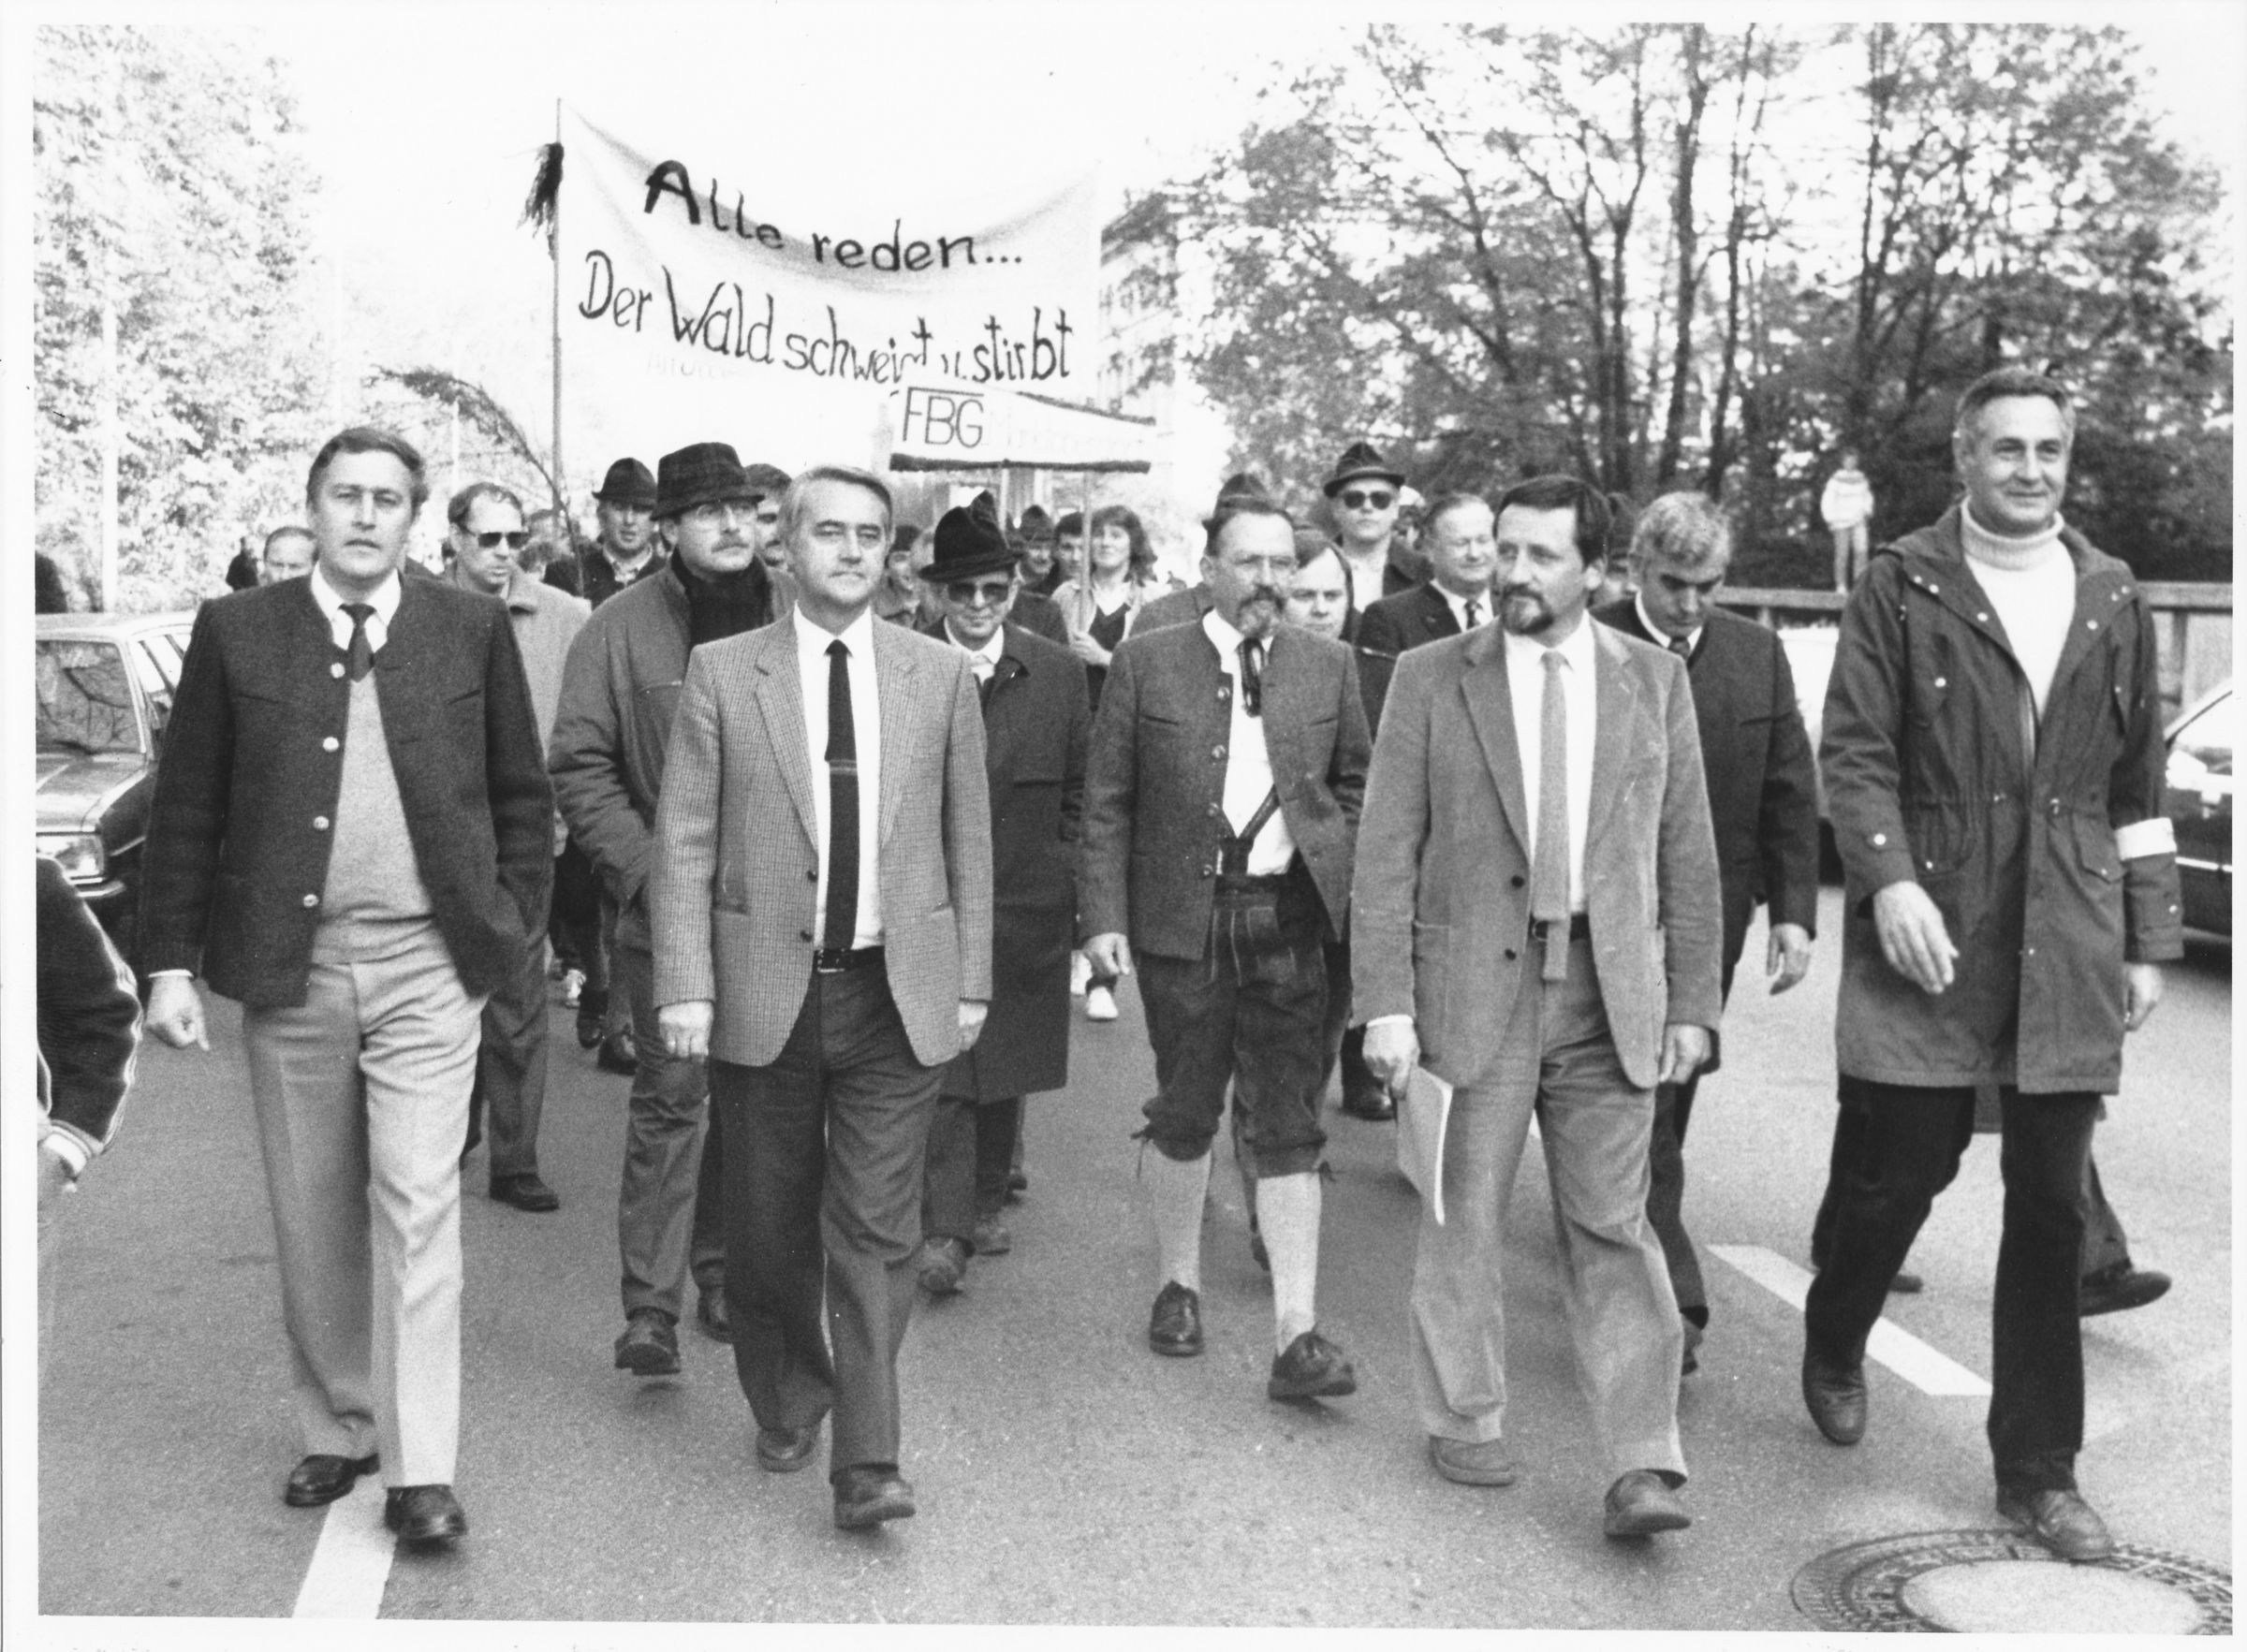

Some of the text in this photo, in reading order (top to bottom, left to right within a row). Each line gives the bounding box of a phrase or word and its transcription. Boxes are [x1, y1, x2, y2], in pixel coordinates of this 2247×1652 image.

[644, 159, 1022, 271] Alle reden...
[578, 249, 653, 332] Der
[662, 264, 774, 365] Wald
[971, 305, 1074, 383] stirbt
[902, 386, 985, 449] FBG
